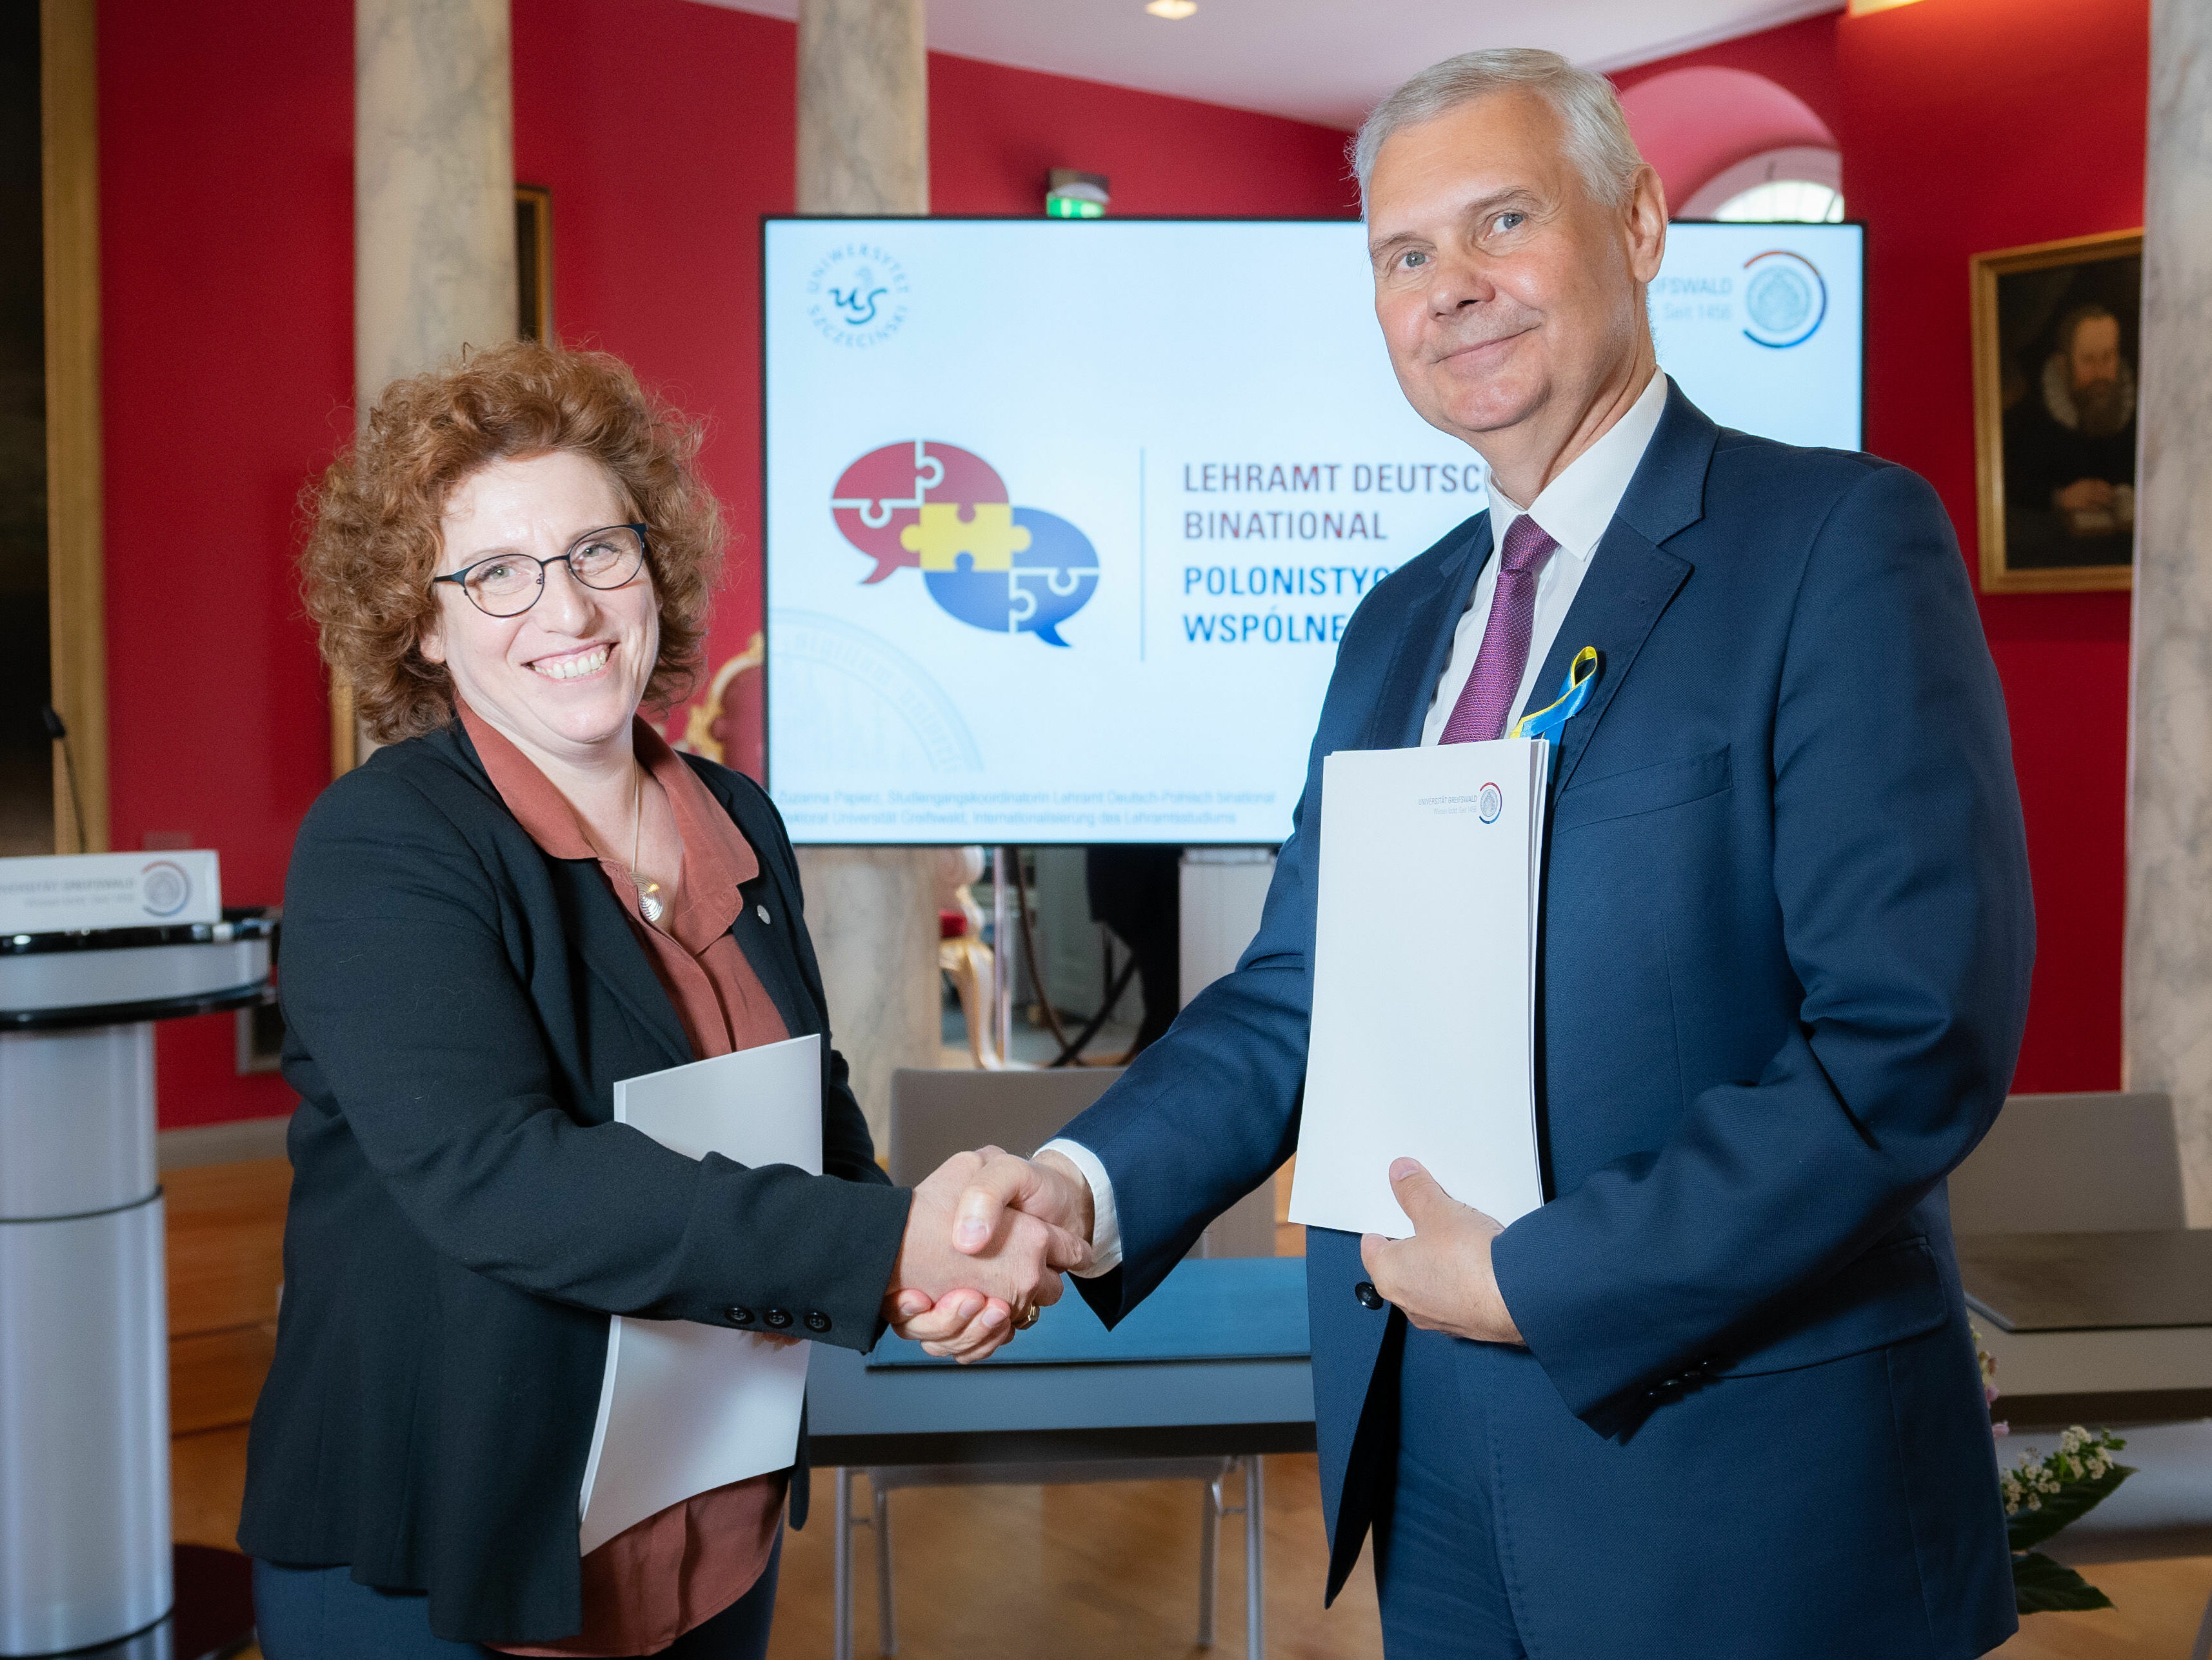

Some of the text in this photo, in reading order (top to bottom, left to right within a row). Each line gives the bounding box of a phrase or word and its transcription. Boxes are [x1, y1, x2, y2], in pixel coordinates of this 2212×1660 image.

[1184, 463, 1488, 494] LEHRAMT DEUTSC
[1184, 510, 1387, 540] BINATIONAL
[1182, 605, 1346, 643] WSPÓLNE
